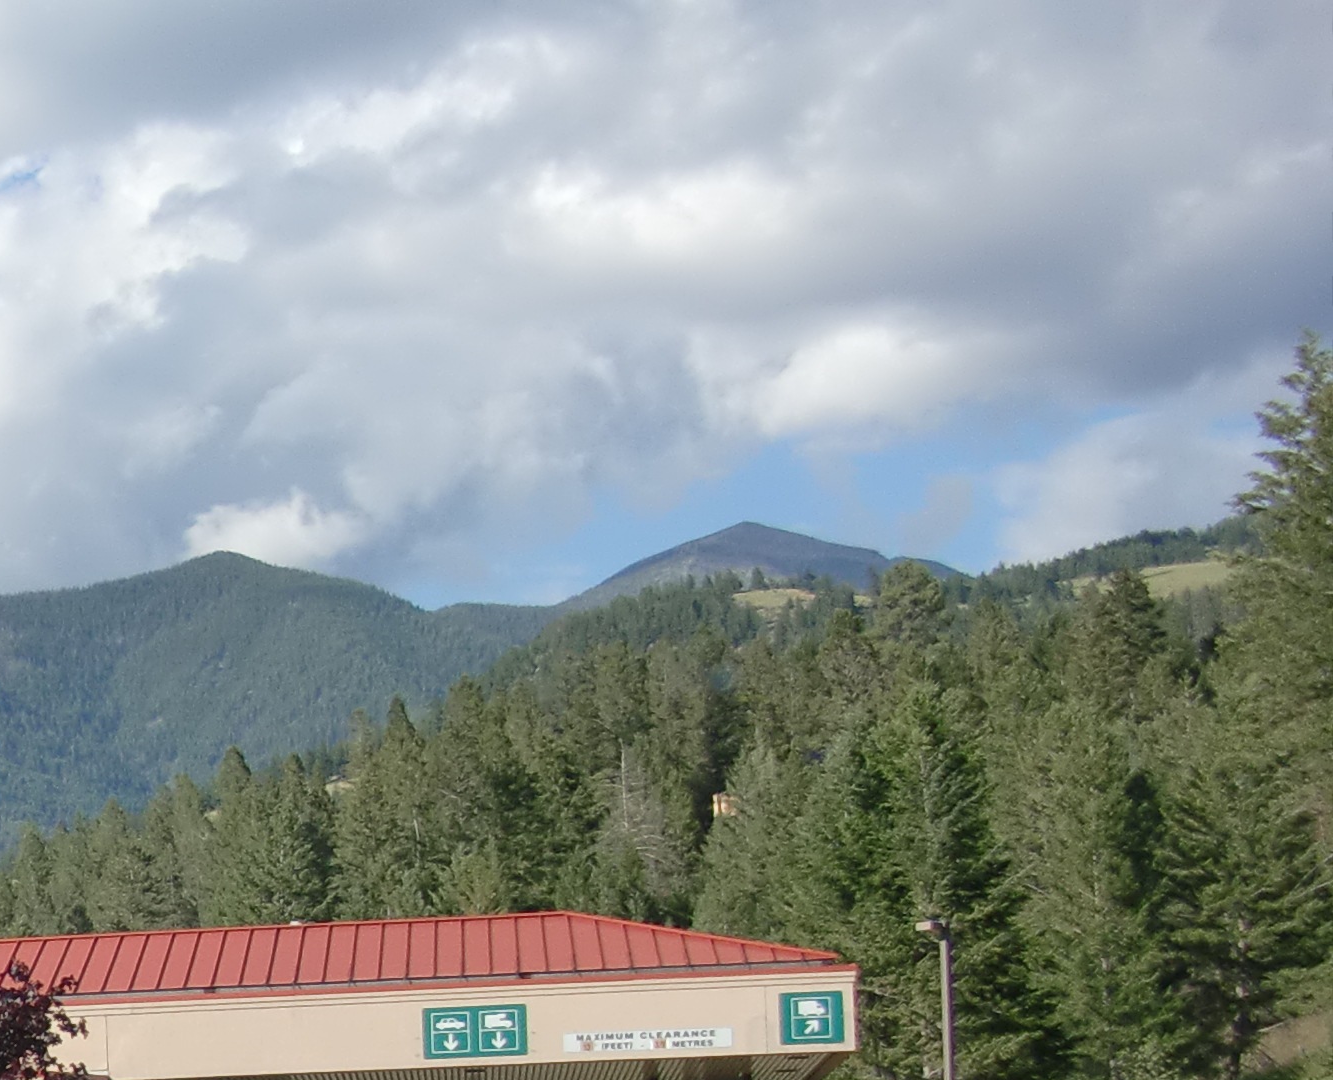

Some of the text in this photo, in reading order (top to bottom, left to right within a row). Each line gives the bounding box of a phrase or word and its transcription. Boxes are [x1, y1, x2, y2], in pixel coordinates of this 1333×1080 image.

[576, 1029, 716, 1042] MAXIMUM CLEARANCE
[671, 1039, 714, 1048] METRES
